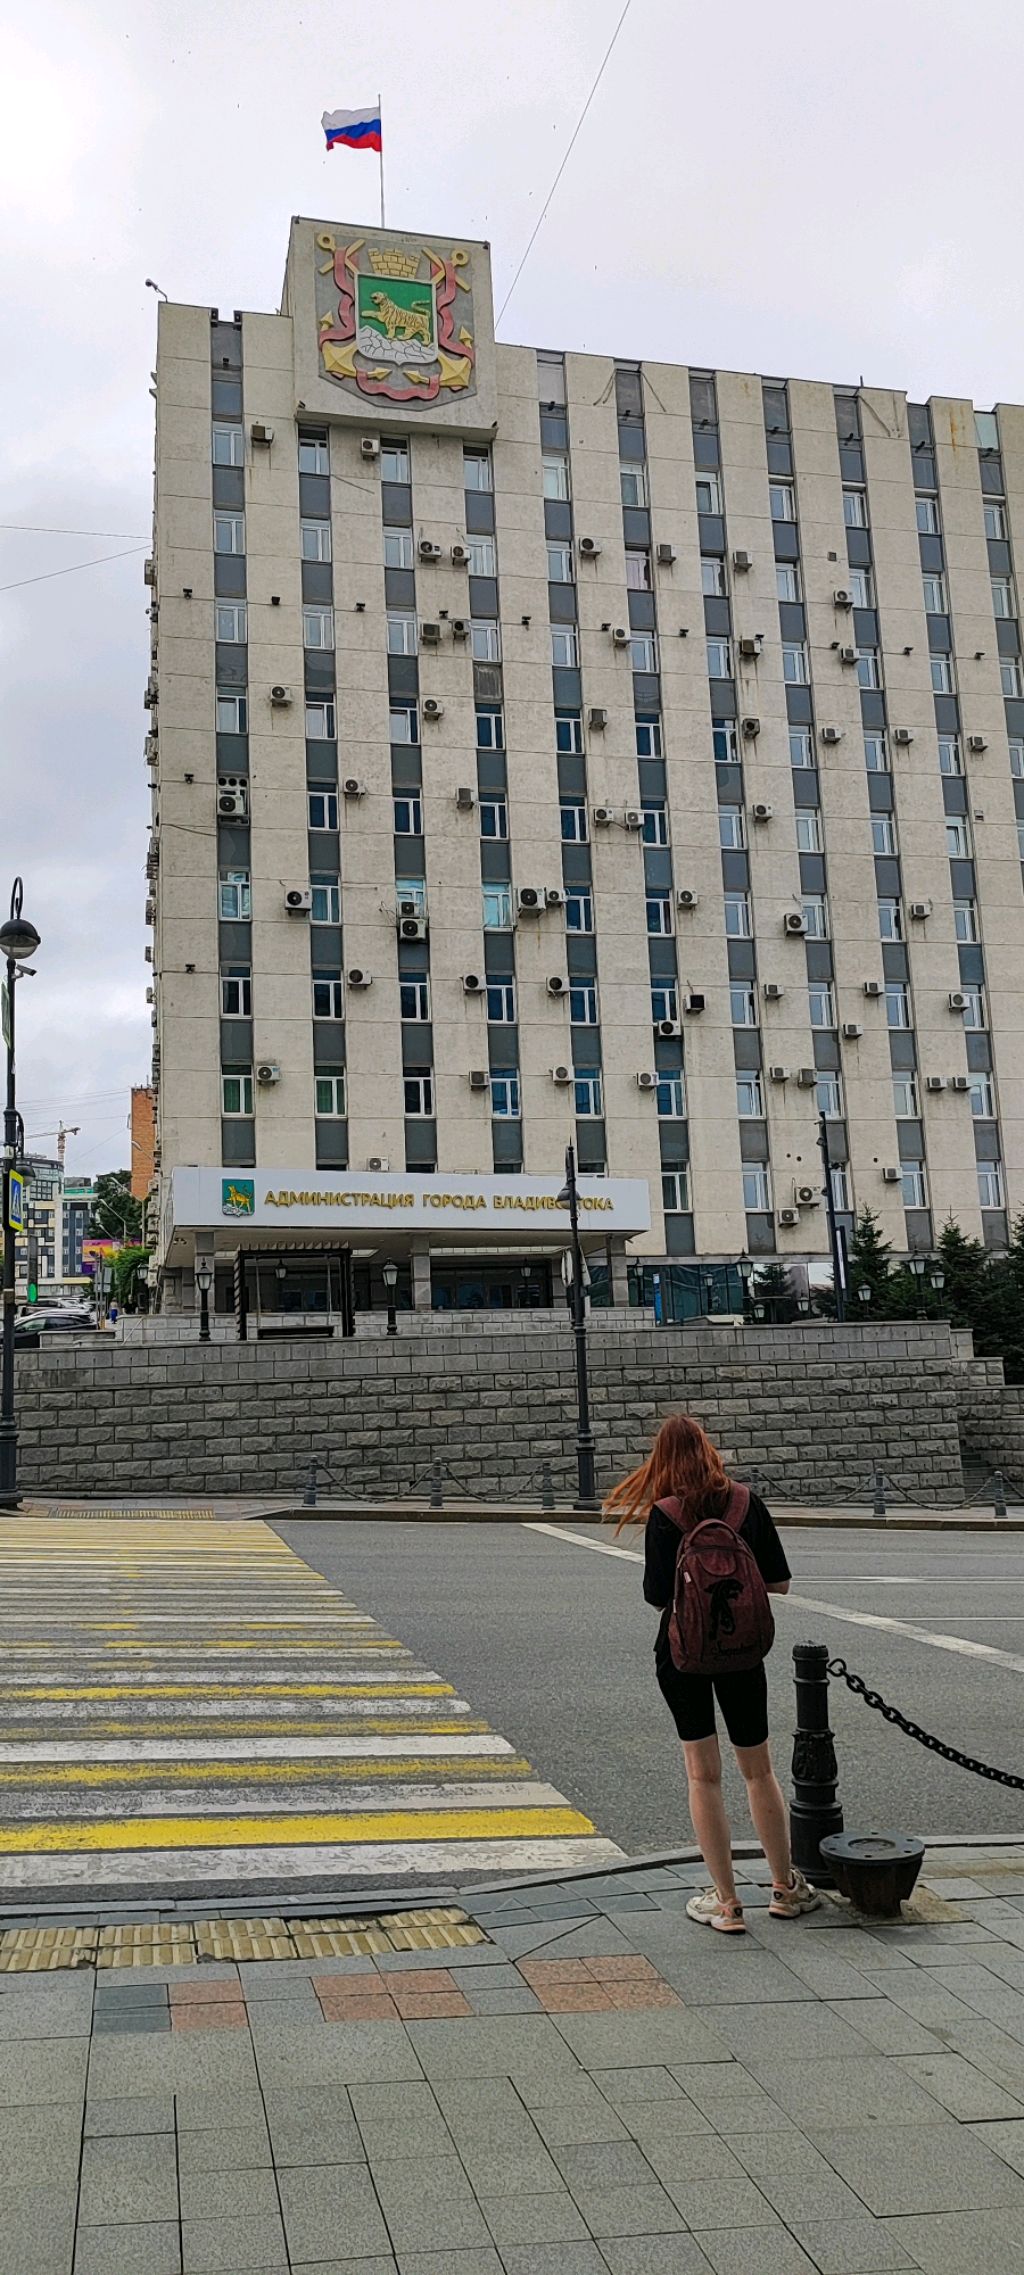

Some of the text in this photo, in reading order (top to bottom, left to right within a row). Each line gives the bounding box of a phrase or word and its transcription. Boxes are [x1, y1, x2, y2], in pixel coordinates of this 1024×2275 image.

[264, 1190, 614, 1211] АДМИНИСТРАЦИЯ ГОРОДА ВЛАДИВТОКА
